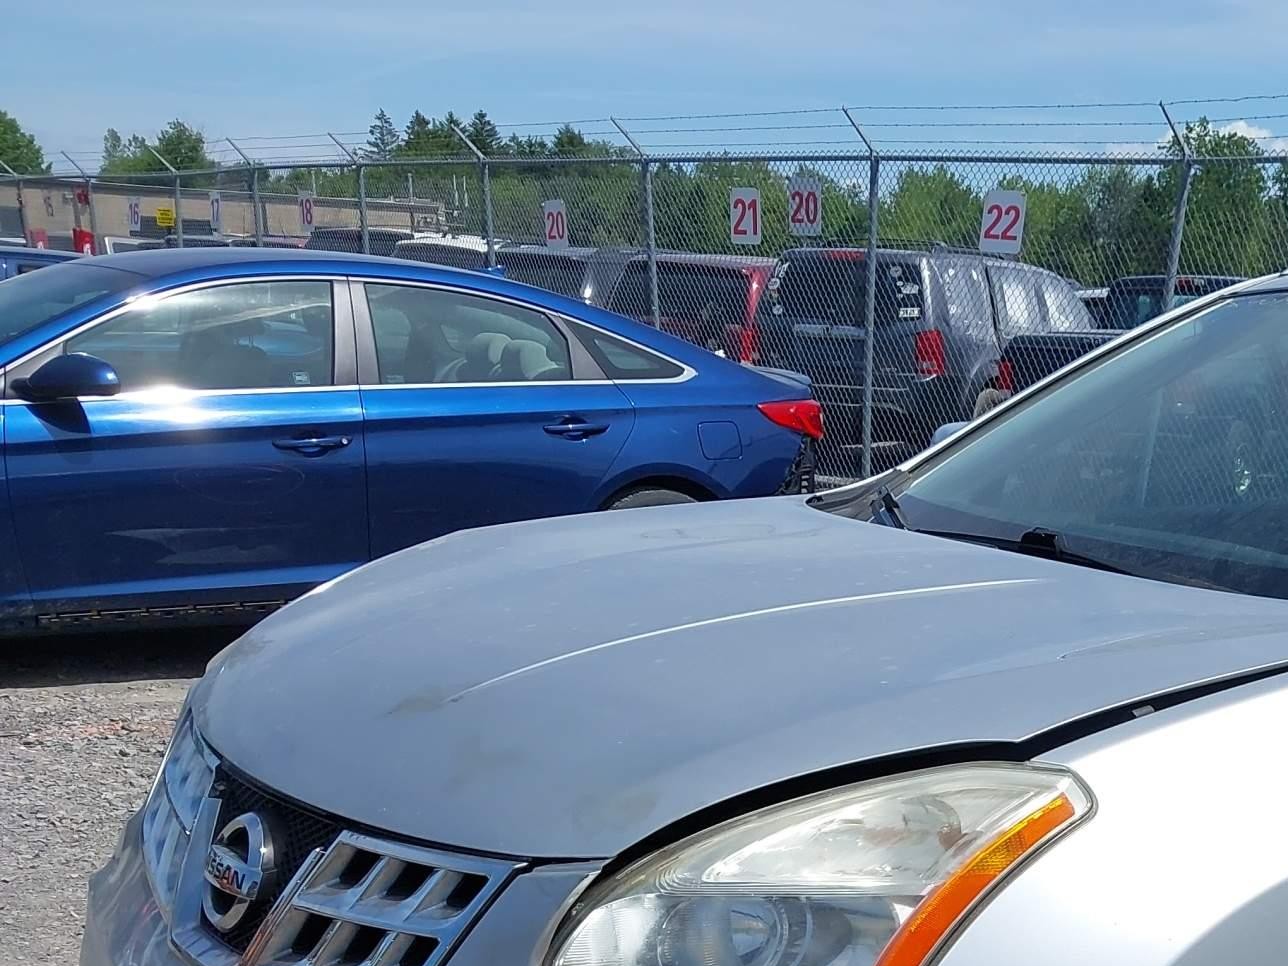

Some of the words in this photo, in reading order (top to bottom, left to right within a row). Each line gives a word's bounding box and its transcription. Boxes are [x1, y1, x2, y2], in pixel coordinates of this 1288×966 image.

[129, 203, 140, 225] 16
[299, 199, 313, 225] 18
[732, 197, 759, 236] 21
[790, 190, 818, 225] 20
[983, 203, 1021, 241] 22
[546, 211, 565, 240] 20
[207, 858, 246, 890] SSAN
